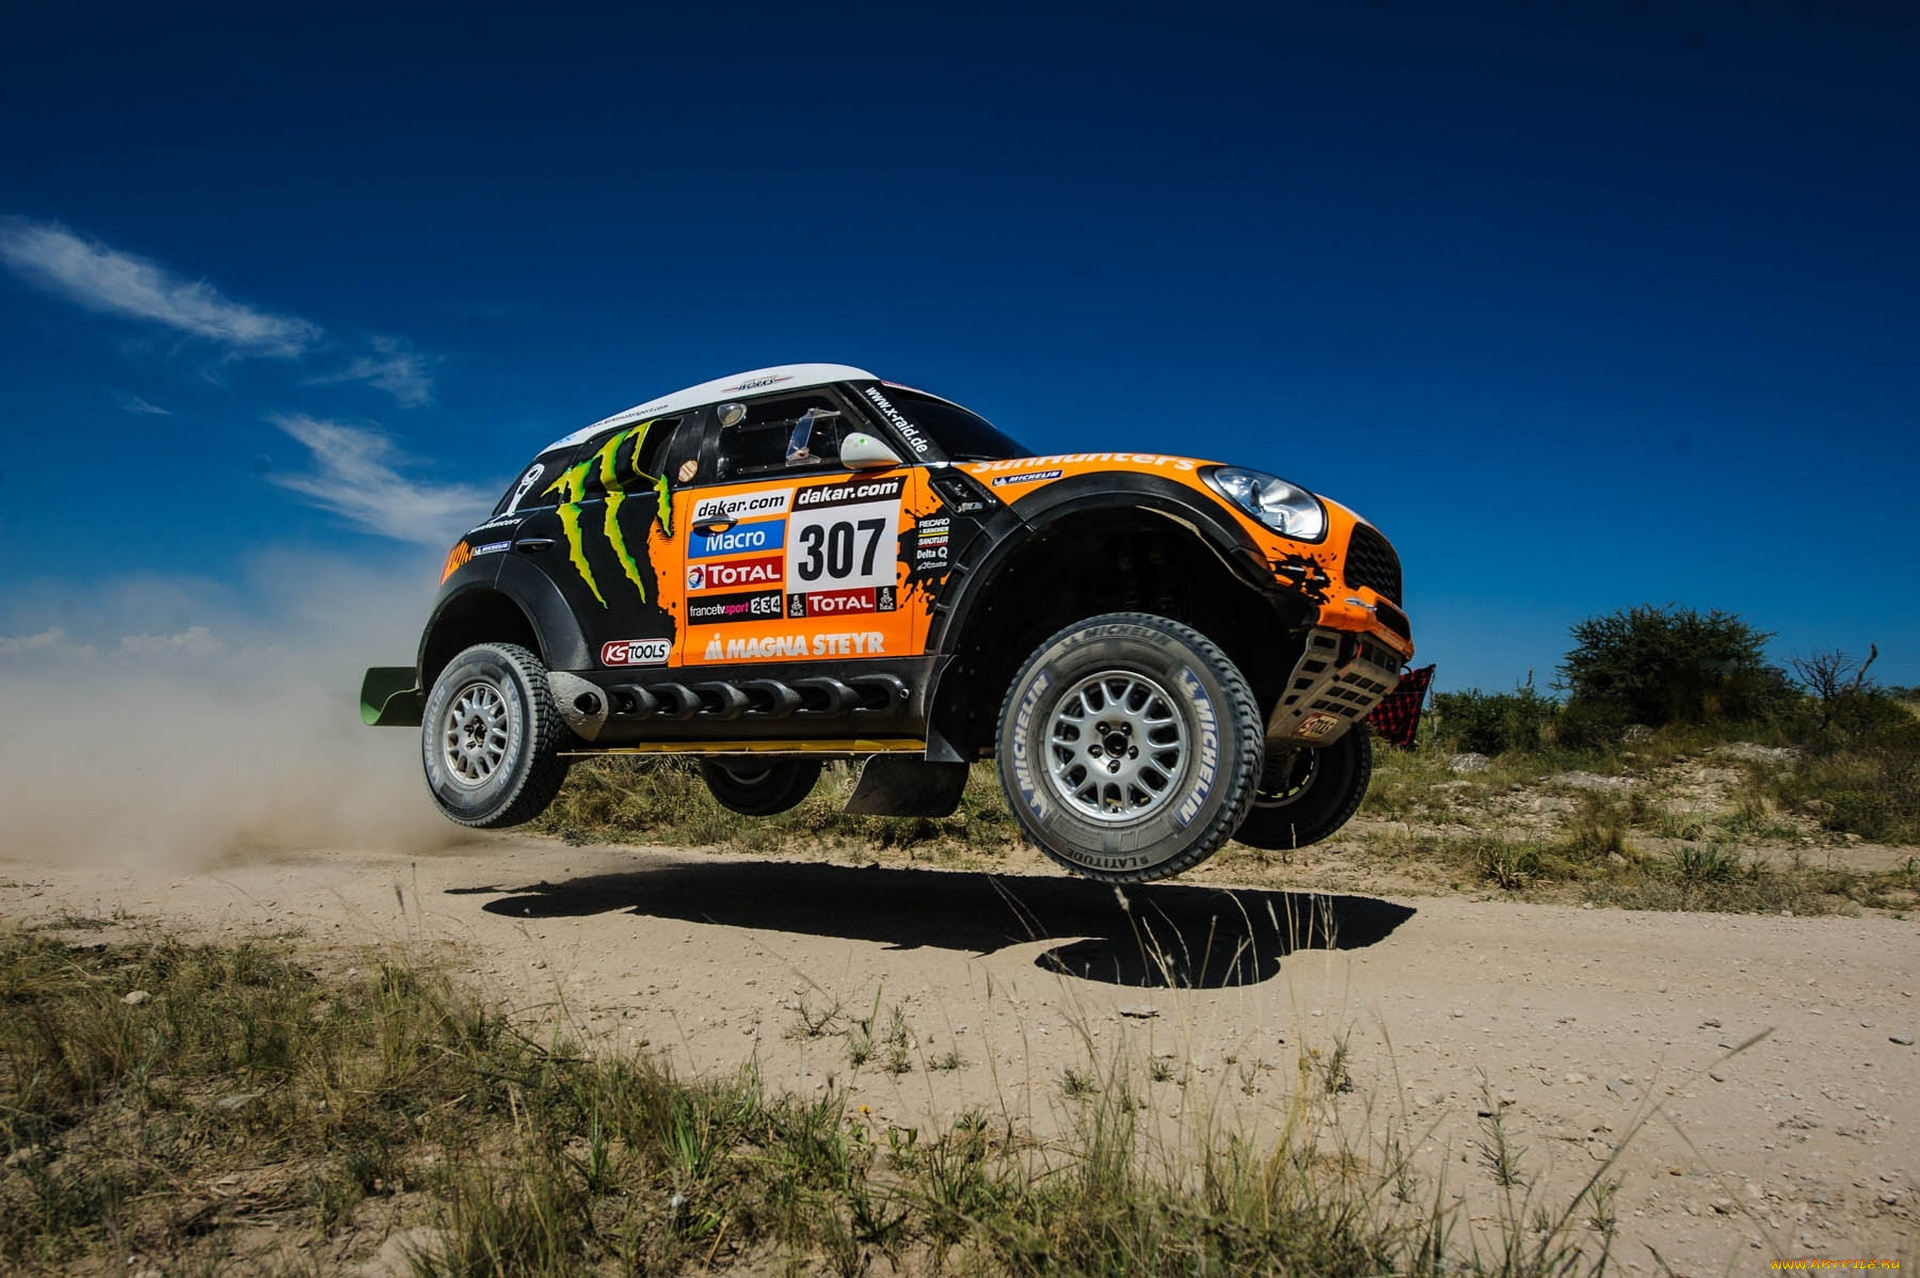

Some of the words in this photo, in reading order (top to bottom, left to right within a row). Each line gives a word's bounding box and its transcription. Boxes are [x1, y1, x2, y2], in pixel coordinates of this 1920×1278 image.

[865, 387, 928, 452] www.x-raid.de
[1008, 471, 1060, 483] MICHELIN
[797, 481, 899, 505] dakar.com
[697, 495, 785, 517] dakar.com
[919, 518, 950, 528] RECARO
[705, 530, 766, 553] Macro
[796, 517, 887, 581] 307
[917, 549, 936, 559] Delta
[937, 546, 948, 559] Q
[708, 563, 781, 585] TOTAL
[808, 595, 874, 612] TOTAL
[726, 634, 809, 660] MAGNA
[812, 631, 885, 656] STEYR
[1014, 674, 1049, 791] MICHELIN
[1181, 698, 1216, 824] MICHELIN
[1066, 847, 1138, 870] LATITUDE
